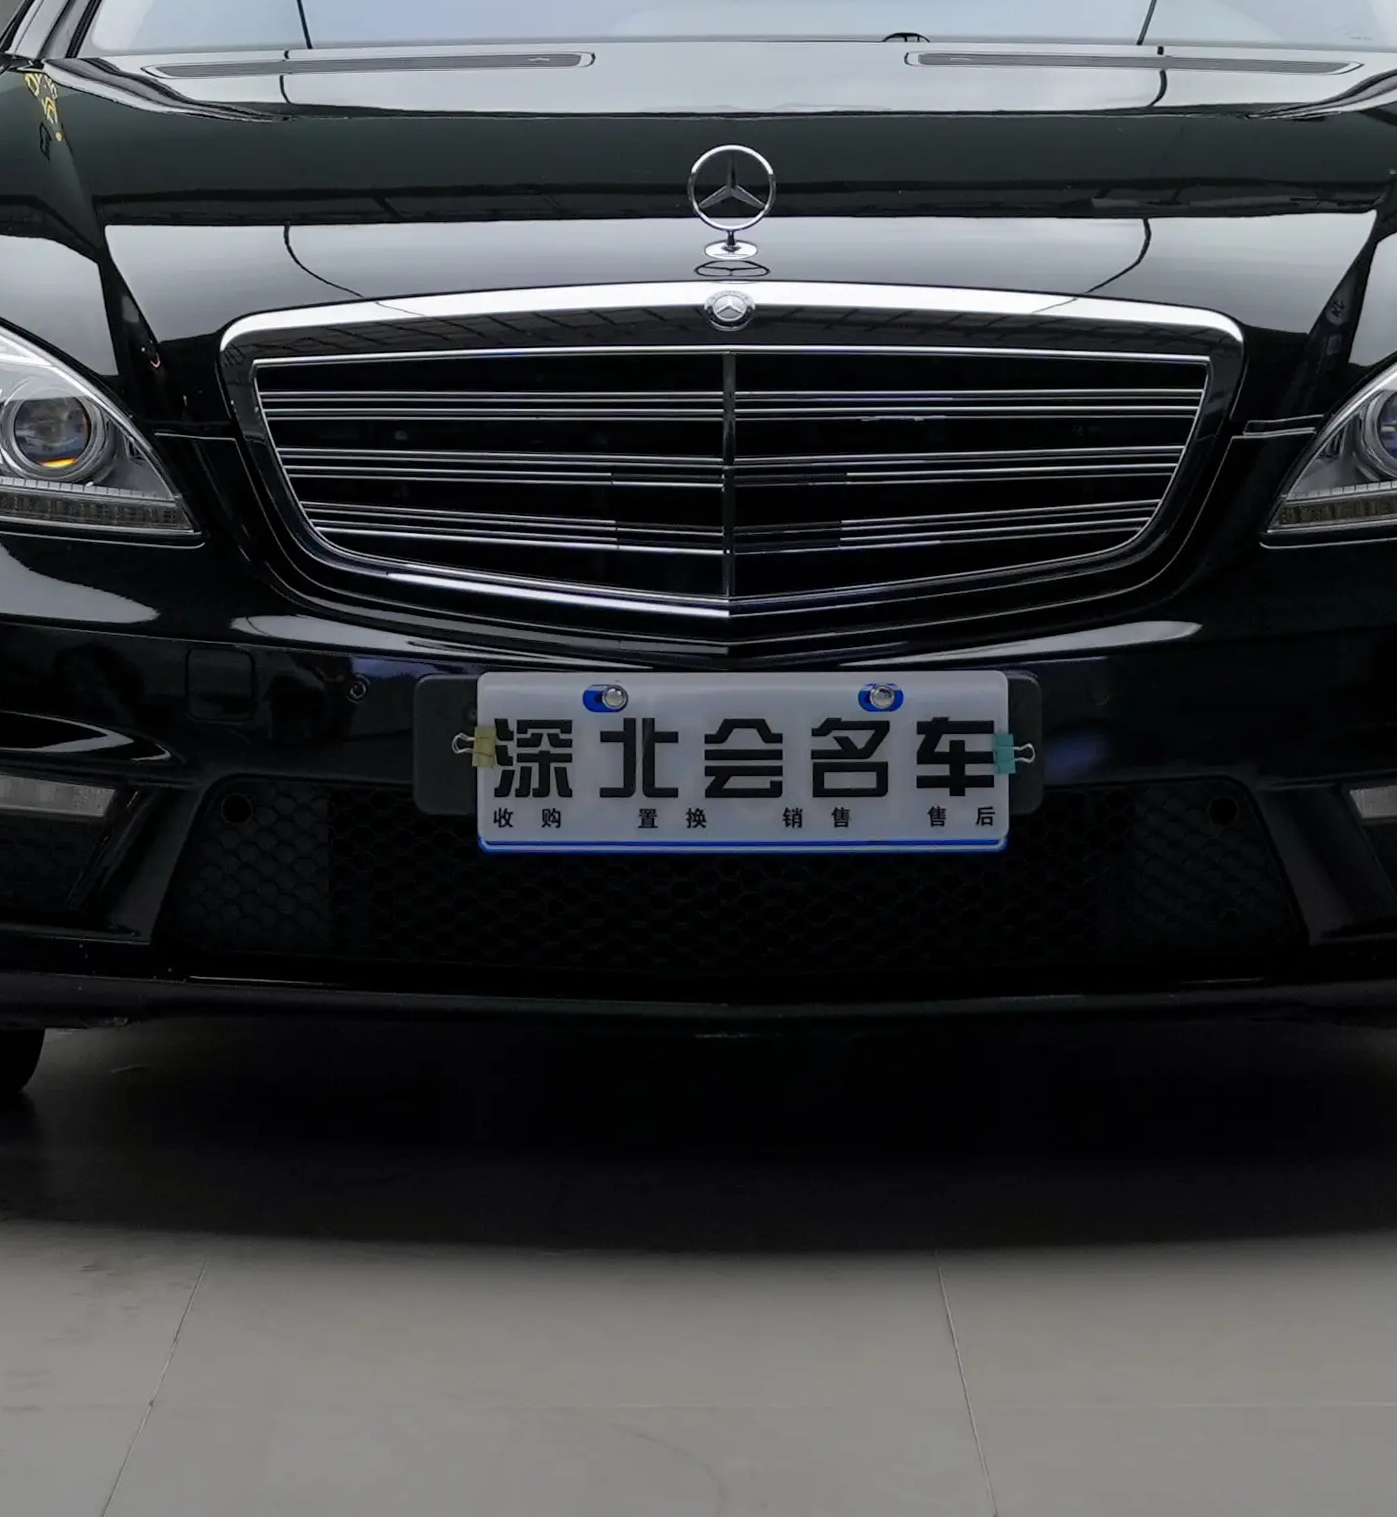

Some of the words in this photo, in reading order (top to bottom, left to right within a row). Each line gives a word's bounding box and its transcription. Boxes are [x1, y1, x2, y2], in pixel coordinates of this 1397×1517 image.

[494, 717, 995, 798] 深北会名车
[493, 807, 562, 829] 收购
[638, 807, 708, 829] 置换
[782, 806, 851, 829] 销售
[927, 805, 996, 828] 售后
